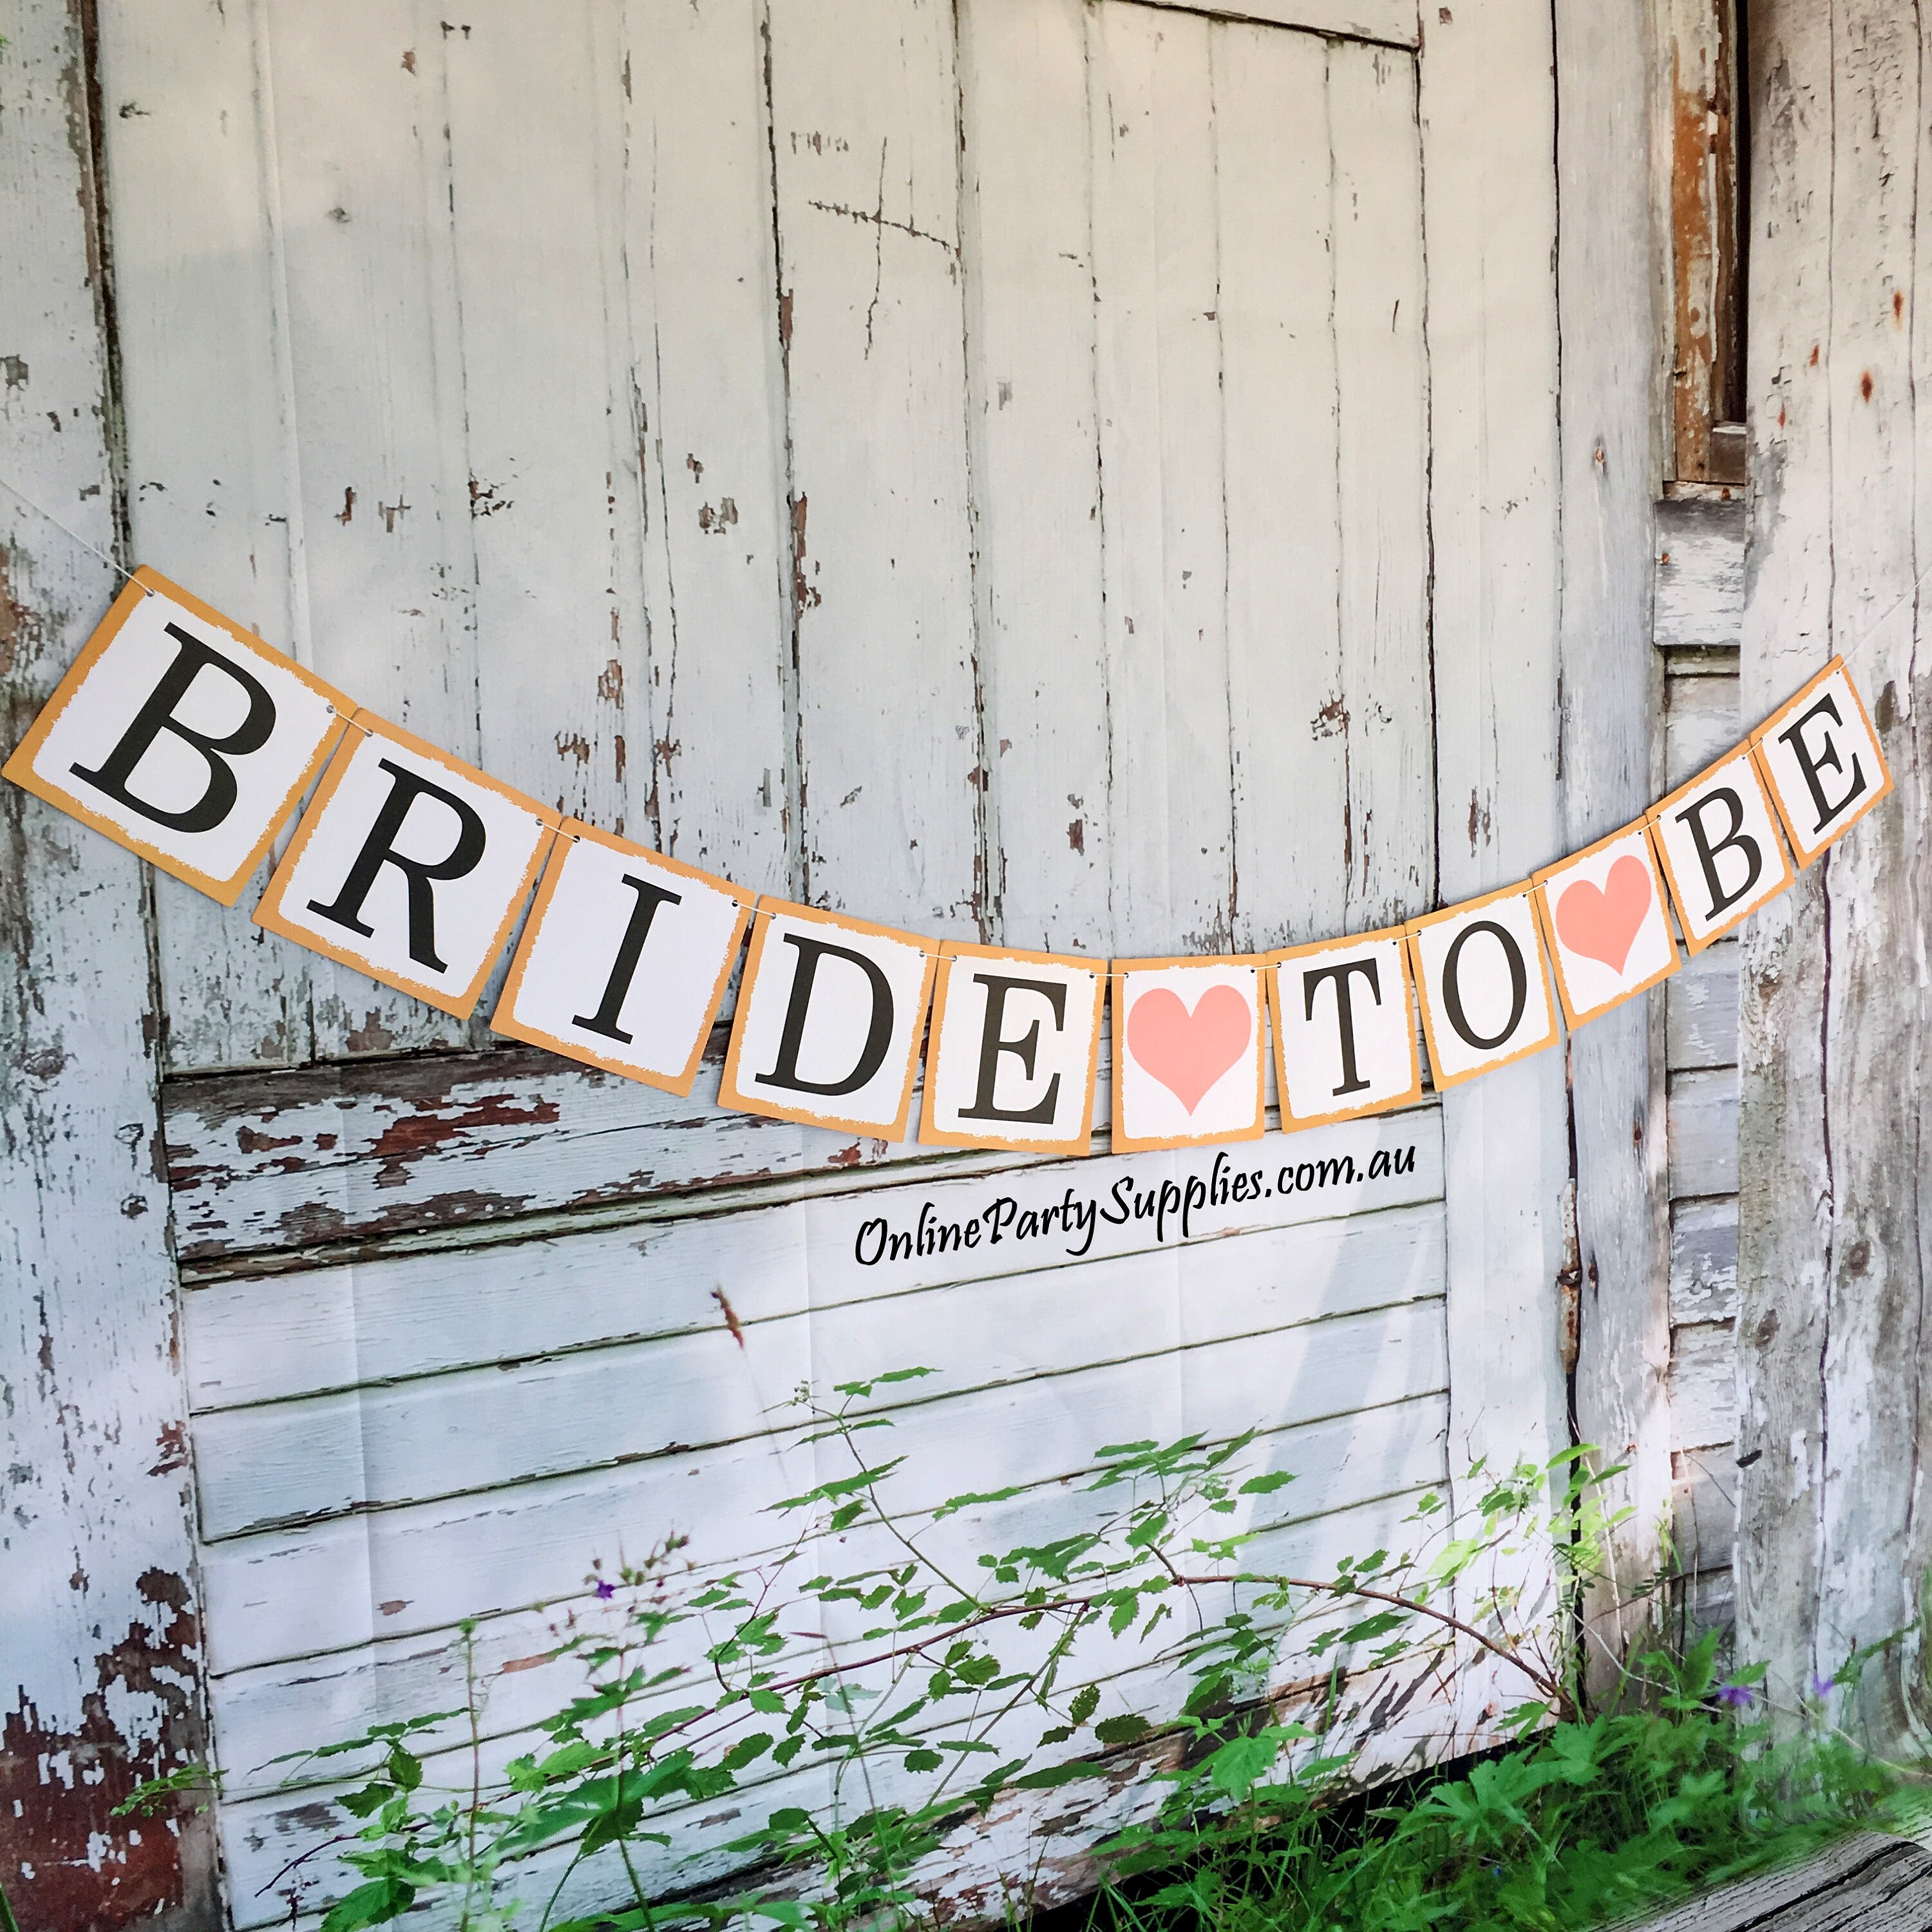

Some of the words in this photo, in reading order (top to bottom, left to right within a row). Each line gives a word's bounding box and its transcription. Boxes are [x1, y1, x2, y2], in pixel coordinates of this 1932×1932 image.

[70, 621, 1066, 1125] BRIDE
[1303, 920, 1527, 1096] TO
[1675, 693, 1867, 921] BE
